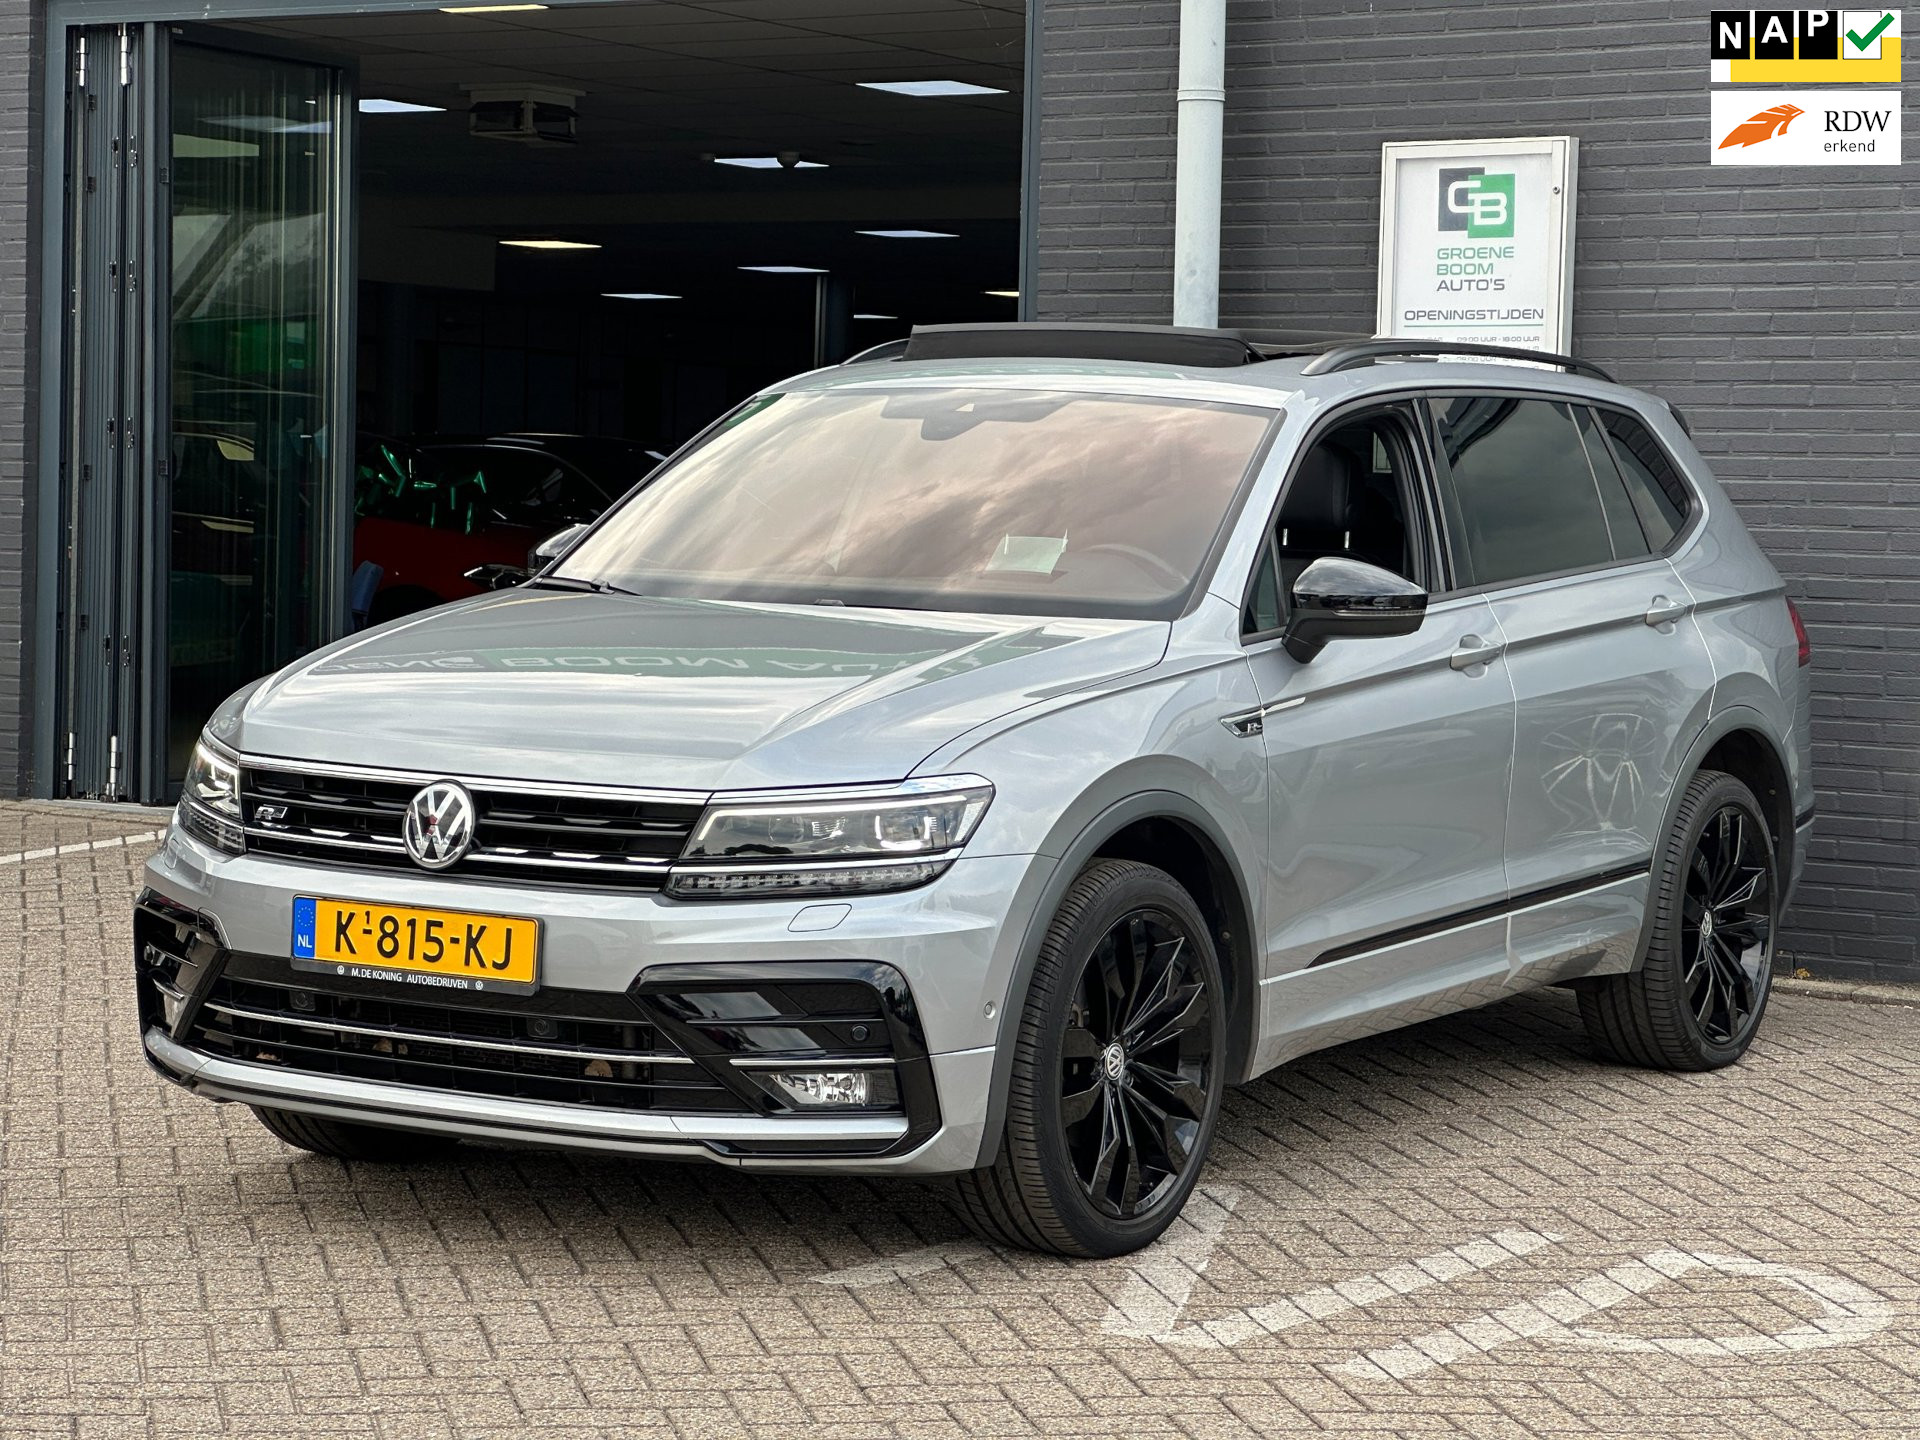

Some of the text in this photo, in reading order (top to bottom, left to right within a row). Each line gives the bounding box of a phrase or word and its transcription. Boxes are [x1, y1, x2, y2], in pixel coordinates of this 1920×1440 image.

[1437, 246, 1514, 260] GROENE
[1436, 263, 1494, 276] BOOM
[1436, 278, 1505, 291] AUTO'S
[1404, 308, 1544, 321] OPENINGSTIJDEN
[297, 934, 313, 949] NL
[361, 970, 372, 979] DE
[372, 970, 402, 983] KONING
[406, 974, 468, 989] AUTOBEDRIJVEN
